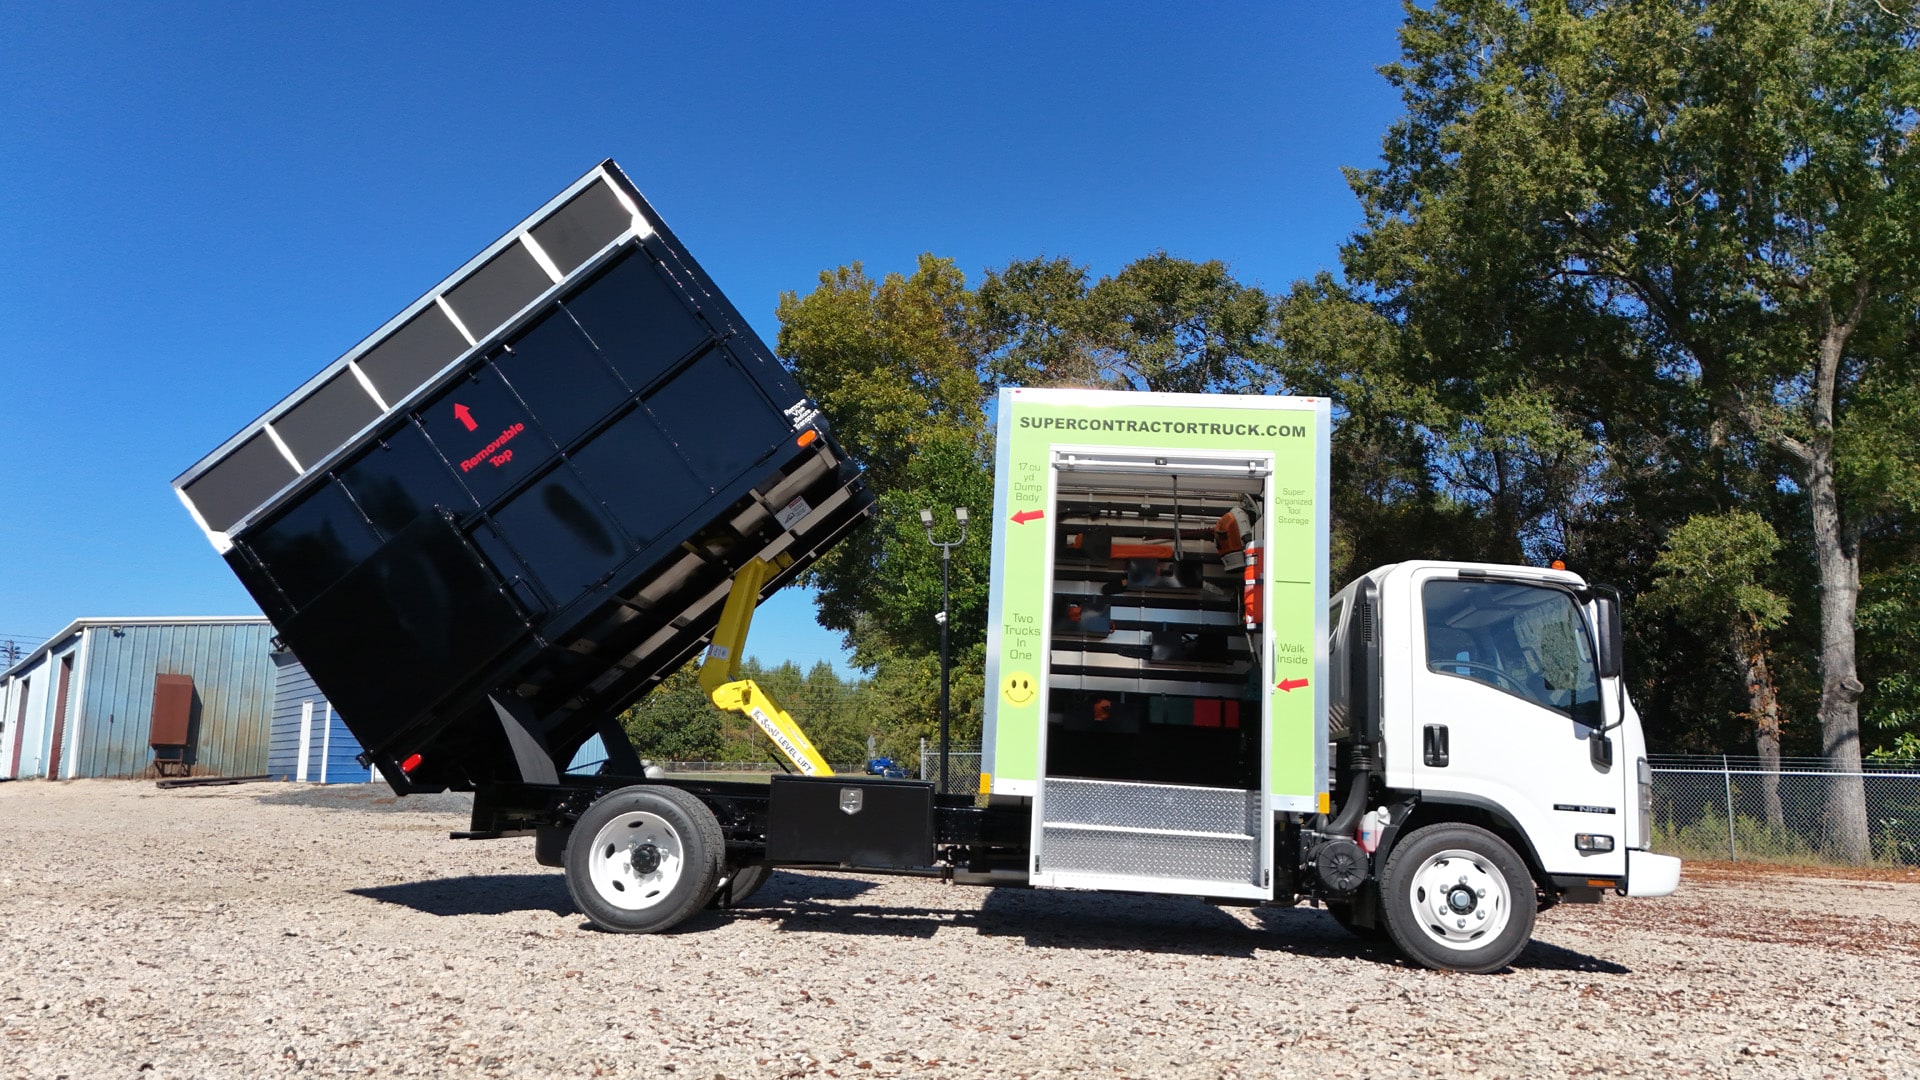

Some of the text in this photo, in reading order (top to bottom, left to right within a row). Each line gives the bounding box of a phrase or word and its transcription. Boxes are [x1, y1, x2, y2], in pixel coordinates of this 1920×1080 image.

[1020, 416, 1307, 438] SUPERCONTRACTORTRUCK.COM
[460, 422, 525, 472] Removable
[489, 449, 513, 467] Top
[1018, 462, 1028, 471] 17
[1023, 473, 1035, 482] yd
[1014, 482, 1042, 492] Dump
[1282, 487, 1305, 496] Super
[1015, 492, 1039, 503] Body
[1275, 496, 1313, 506] Organized
[1287, 506, 1301, 515] Tool
[1278, 515, 1309, 525] Storage
[1012, 613, 1033, 623] Two
[1004, 624, 1041, 636] Trucks
[1016, 638, 1026, 647] In
[1279, 643, 1305, 653] Walk
[1009, 649, 1032, 660] One
[1277, 654, 1308, 664] Inside
[778, 736, 797, 758] LEVEL
[797, 756, 812, 771] LIFT
